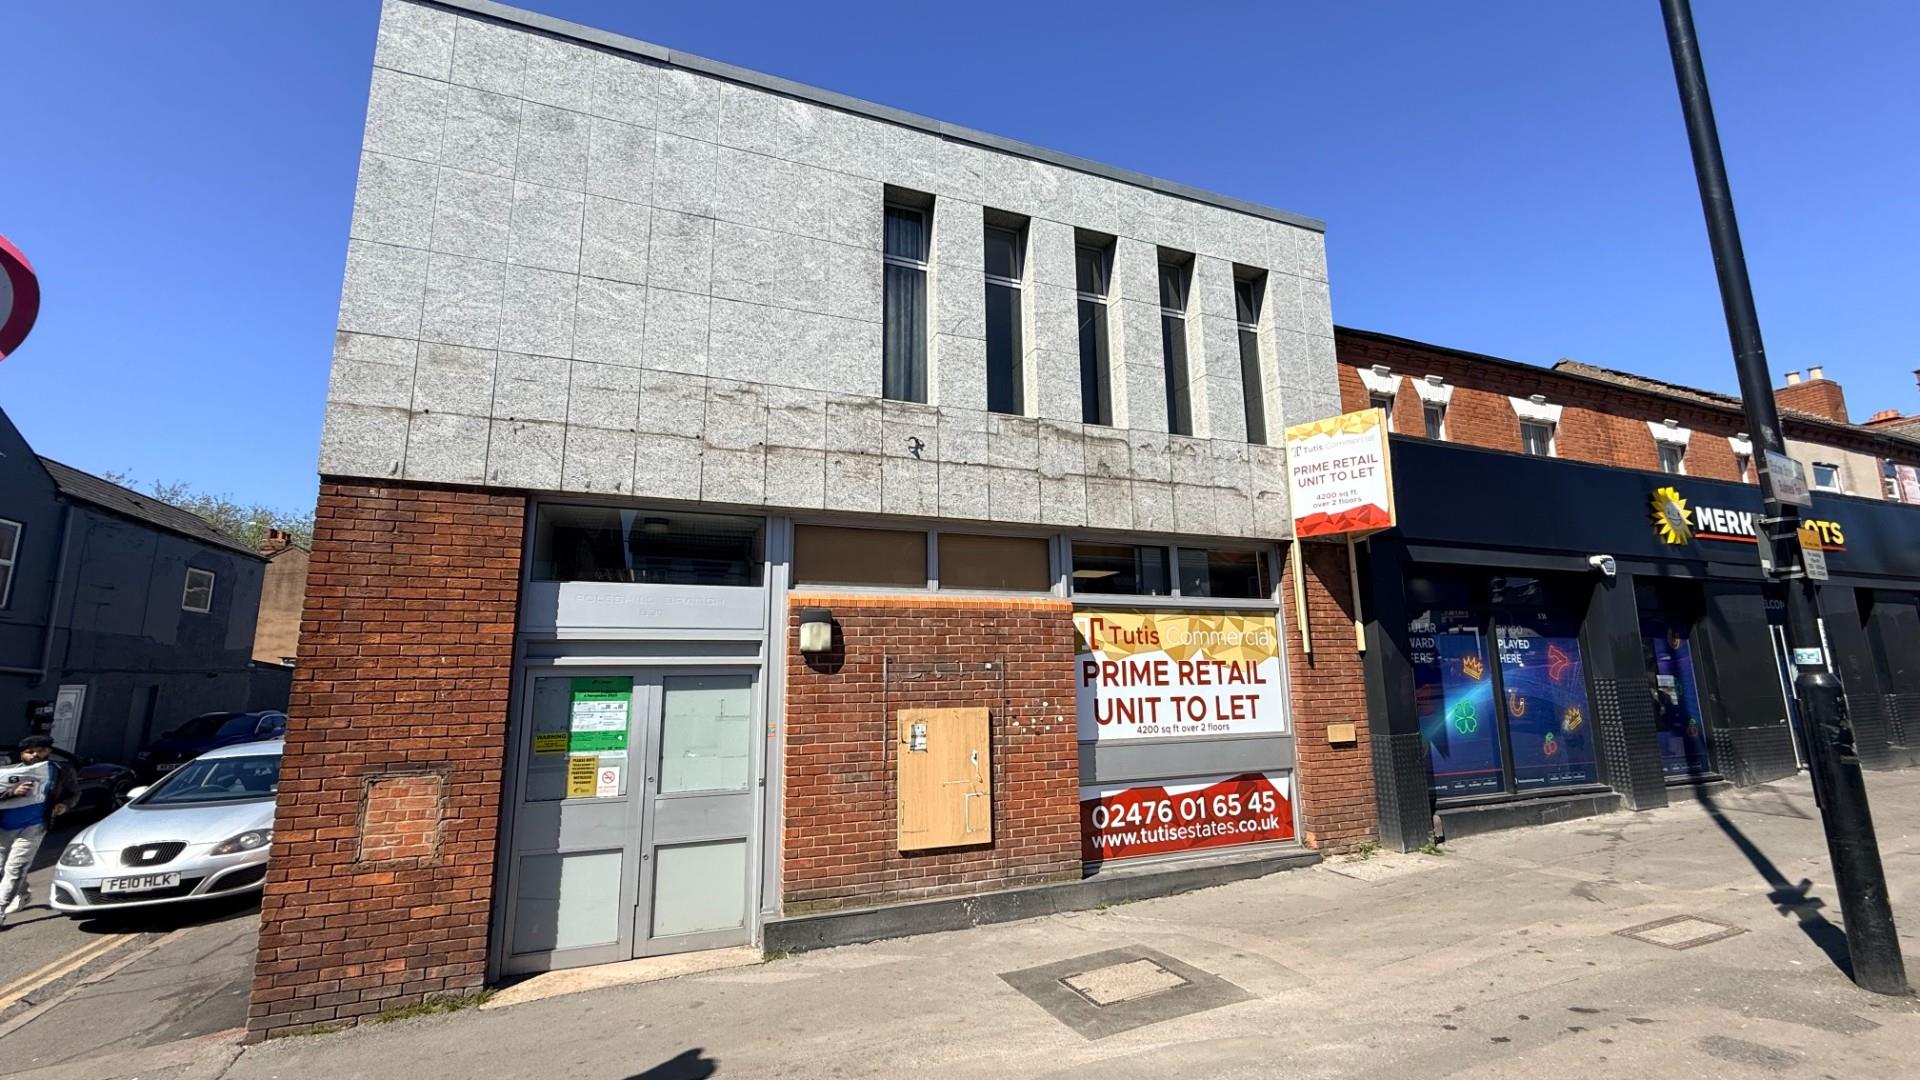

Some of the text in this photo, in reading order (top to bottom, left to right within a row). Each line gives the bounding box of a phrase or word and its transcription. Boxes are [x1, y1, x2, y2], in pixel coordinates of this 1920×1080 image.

[1303, 434, 1376, 454] Tutis Commercial
[1293, 453, 1379, 477] PRIME RETAIL
[1298, 466, 1375, 488] UNIT TO LET
[1313, 501, 1330, 509] over
[1338, 496, 1362, 505] floors
[1316, 491, 1337, 500] 4200
[1339, 490, 1349, 498] sq
[1695, 506, 1757, 536] MERK
[1108, 625, 1272, 647] Tutis Commercial
[1497, 638, 1530, 650] PLAYED
[1499, 653, 1522, 664] HERE
[1082, 660, 1267, 688] PRIME RETAIL
[1093, 694, 1260, 726] UNIT TO LET
[1136, 722, 1230, 735] 4200 sq ft over 2 floors
[1091, 790, 1276, 830] 02476 01 65 45
[1091, 814, 1280, 849] www.tutisestates.co.uk
[110, 874, 172, 890] FE10 HLK
